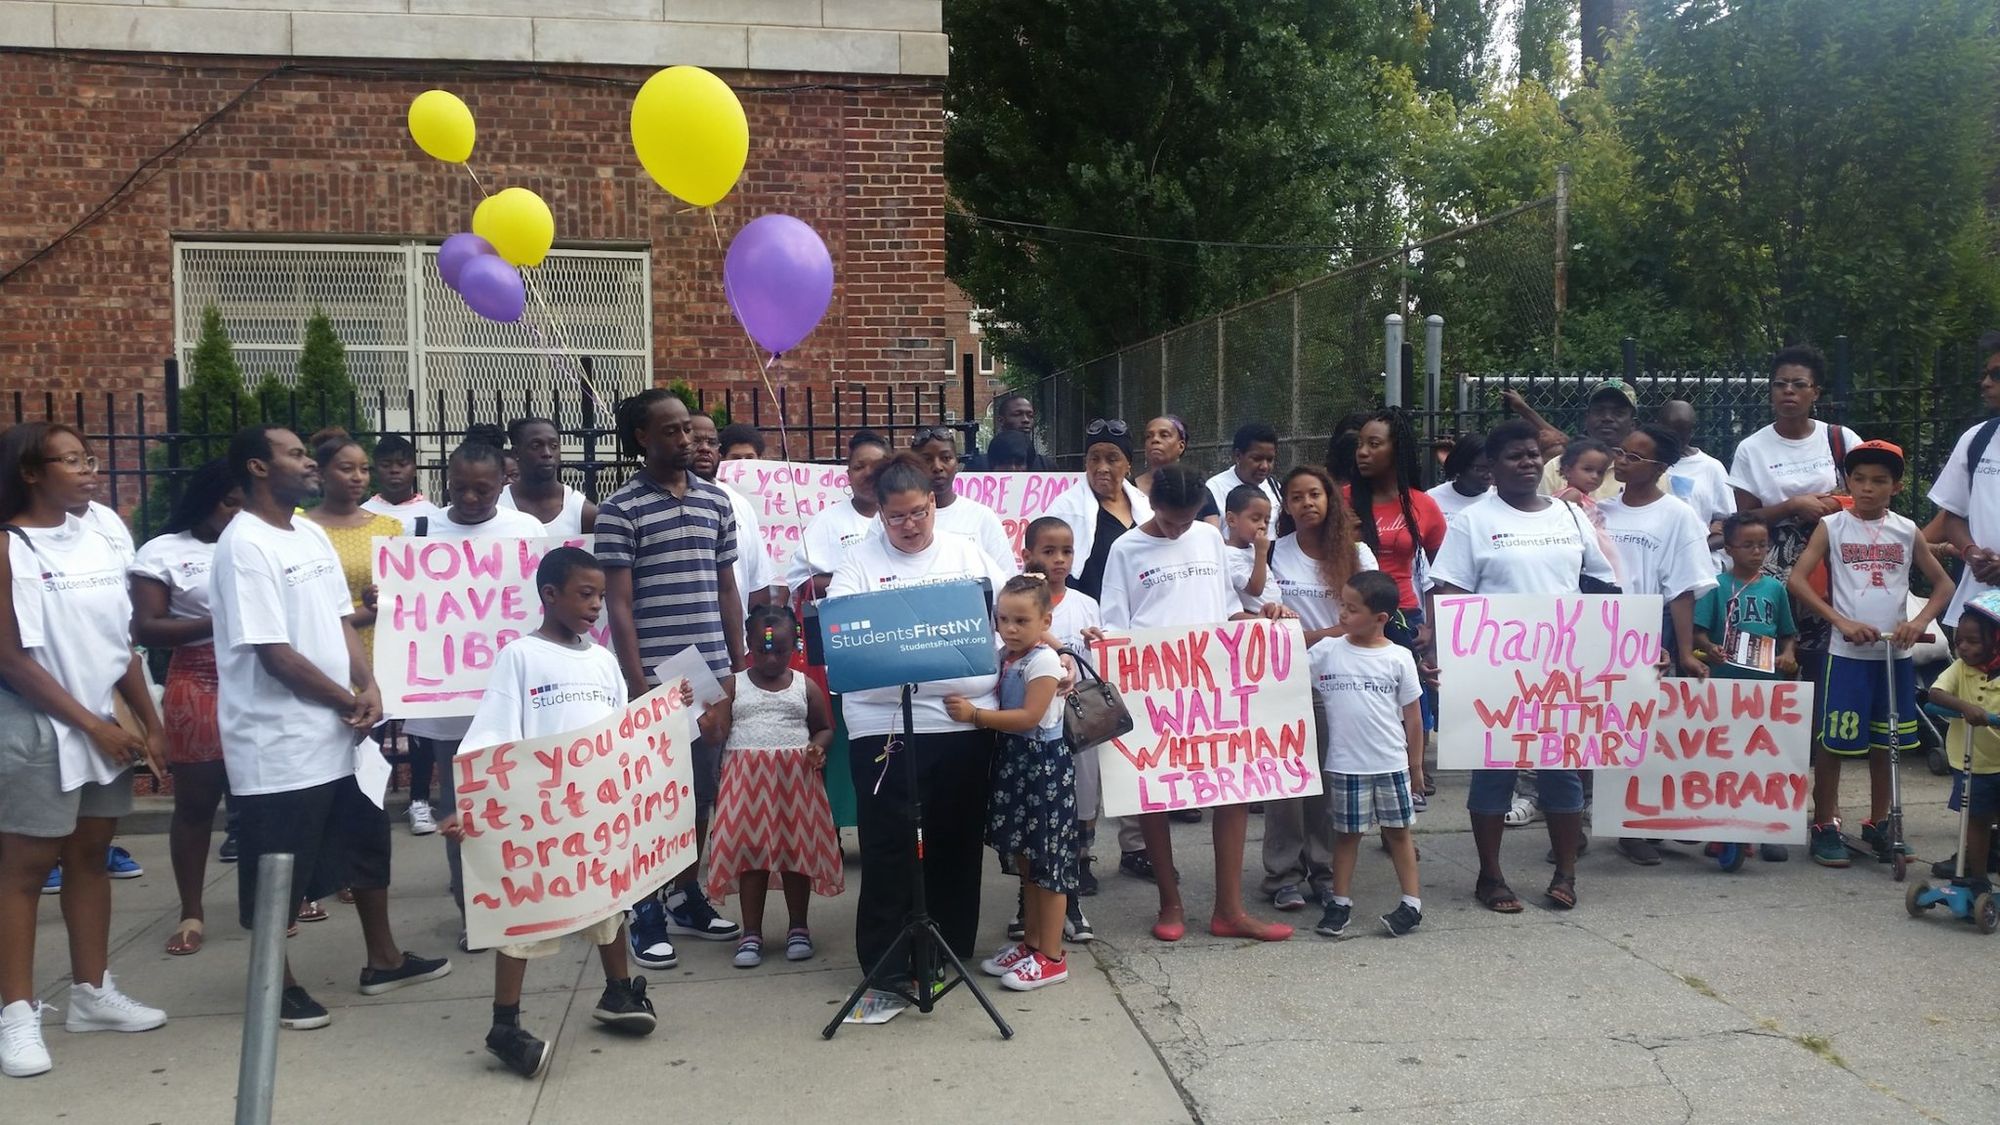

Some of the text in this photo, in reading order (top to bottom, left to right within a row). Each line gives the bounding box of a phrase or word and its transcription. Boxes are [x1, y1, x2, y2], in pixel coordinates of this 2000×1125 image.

[750, 468, 810, 495] you
[379, 539, 503, 581] NOW
[393, 585, 528, 632] HAVE
[1727, 595, 1773, 626] GAP
[831, 617, 983, 649] StudentsFirstNY
[900, 636, 987, 652] StudentsFirstNY.org
[1090, 623, 1291, 693] THANK YOU
[1514, 669, 1627, 704] WALT
[1731, 682, 1802, 725] WE
[1145, 685, 1259, 736] WALT
[1474, 695, 1656, 734] WHITMAN
[1828, 710, 1860, 740] 18
[453, 685, 682, 793] If you done
[1111, 719, 1306, 771] WHITMAN
[1484, 731, 1647, 769] LIBRARY
[1654, 724, 1780, 760] AVE A
[538, 782, 589, 825] it
[597, 731, 675, 804] ain't
[1624, 771, 1808, 816] LIBRARY
[502, 780, 689, 871] bragging.
